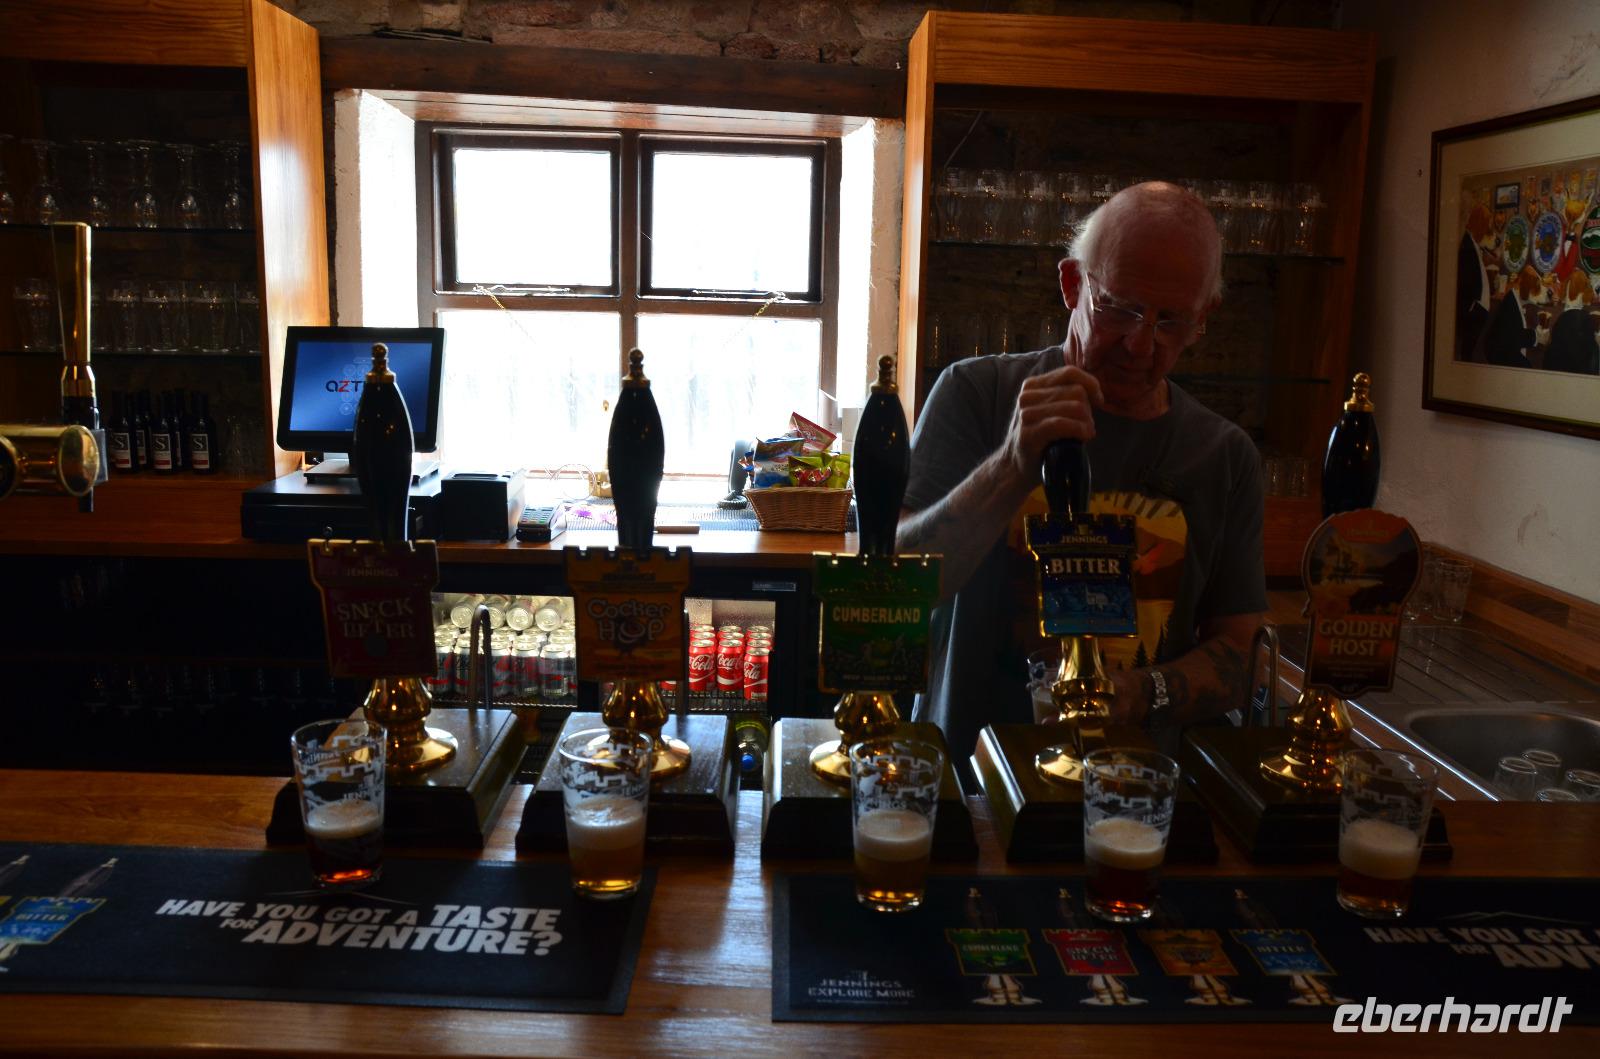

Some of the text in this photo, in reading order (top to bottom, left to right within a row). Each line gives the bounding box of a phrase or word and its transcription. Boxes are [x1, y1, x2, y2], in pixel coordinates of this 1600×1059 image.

[1049, 557, 1121, 575] BITTER
[832, 606, 922, 624] CUMBERLAND
[1318, 618, 1393, 639] GOLDEN
[1329, 637, 1380, 657] HOST
[154, 898, 562, 932] HAVE YOU GOT A TASTE
[219, 918, 564, 956] FOR ADVENTURE?
[1362, 927, 1451, 944] HAVE
[1447, 927, 1521, 944] YOU
[1522, 927, 1591, 944] GOT
[808, 986, 916, 998] EXPLORE MORE
[820, 979, 902, 988] JENNINGS
